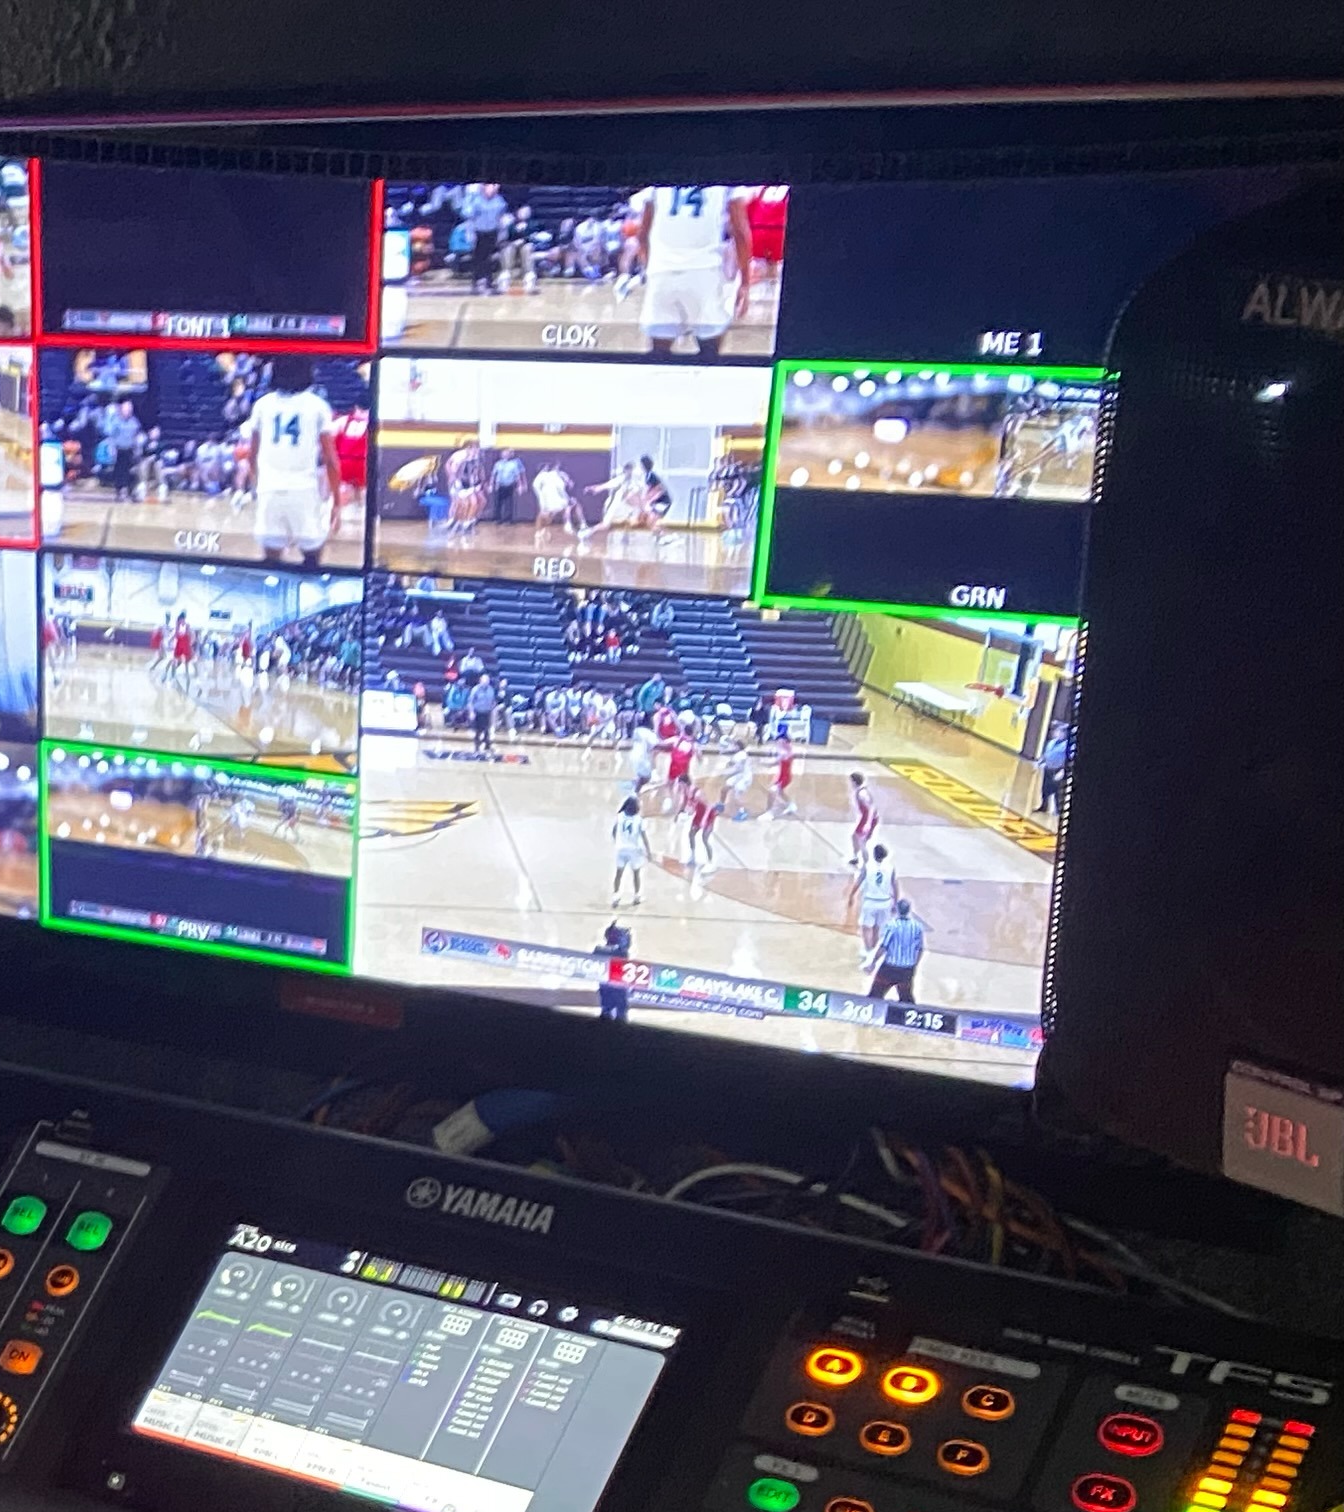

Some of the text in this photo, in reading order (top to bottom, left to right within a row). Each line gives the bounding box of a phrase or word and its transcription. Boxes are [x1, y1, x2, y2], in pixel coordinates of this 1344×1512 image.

[1241, 282, 1344, 328] ALW
[541, 324, 599, 347] CLOK
[981, 331, 1043, 356] ME 1
[270, 412, 303, 447] 14
[174, 530, 221, 552] CLOK
[533, 556, 576, 578] RED
[950, 584, 1007, 608] GRN
[621, 962, 650, 986] 32
[797, 990, 828, 1014] 34
[842, 1000, 873, 1021] 3rd
[904, 1009, 944, 1031] 2:15
[1244, 1104, 1319, 1167] JBL
[440, 1184, 555, 1234] YAMAHA
[227, 1231, 273, 1253] A20
[8, 1349, 31, 1363] ON
